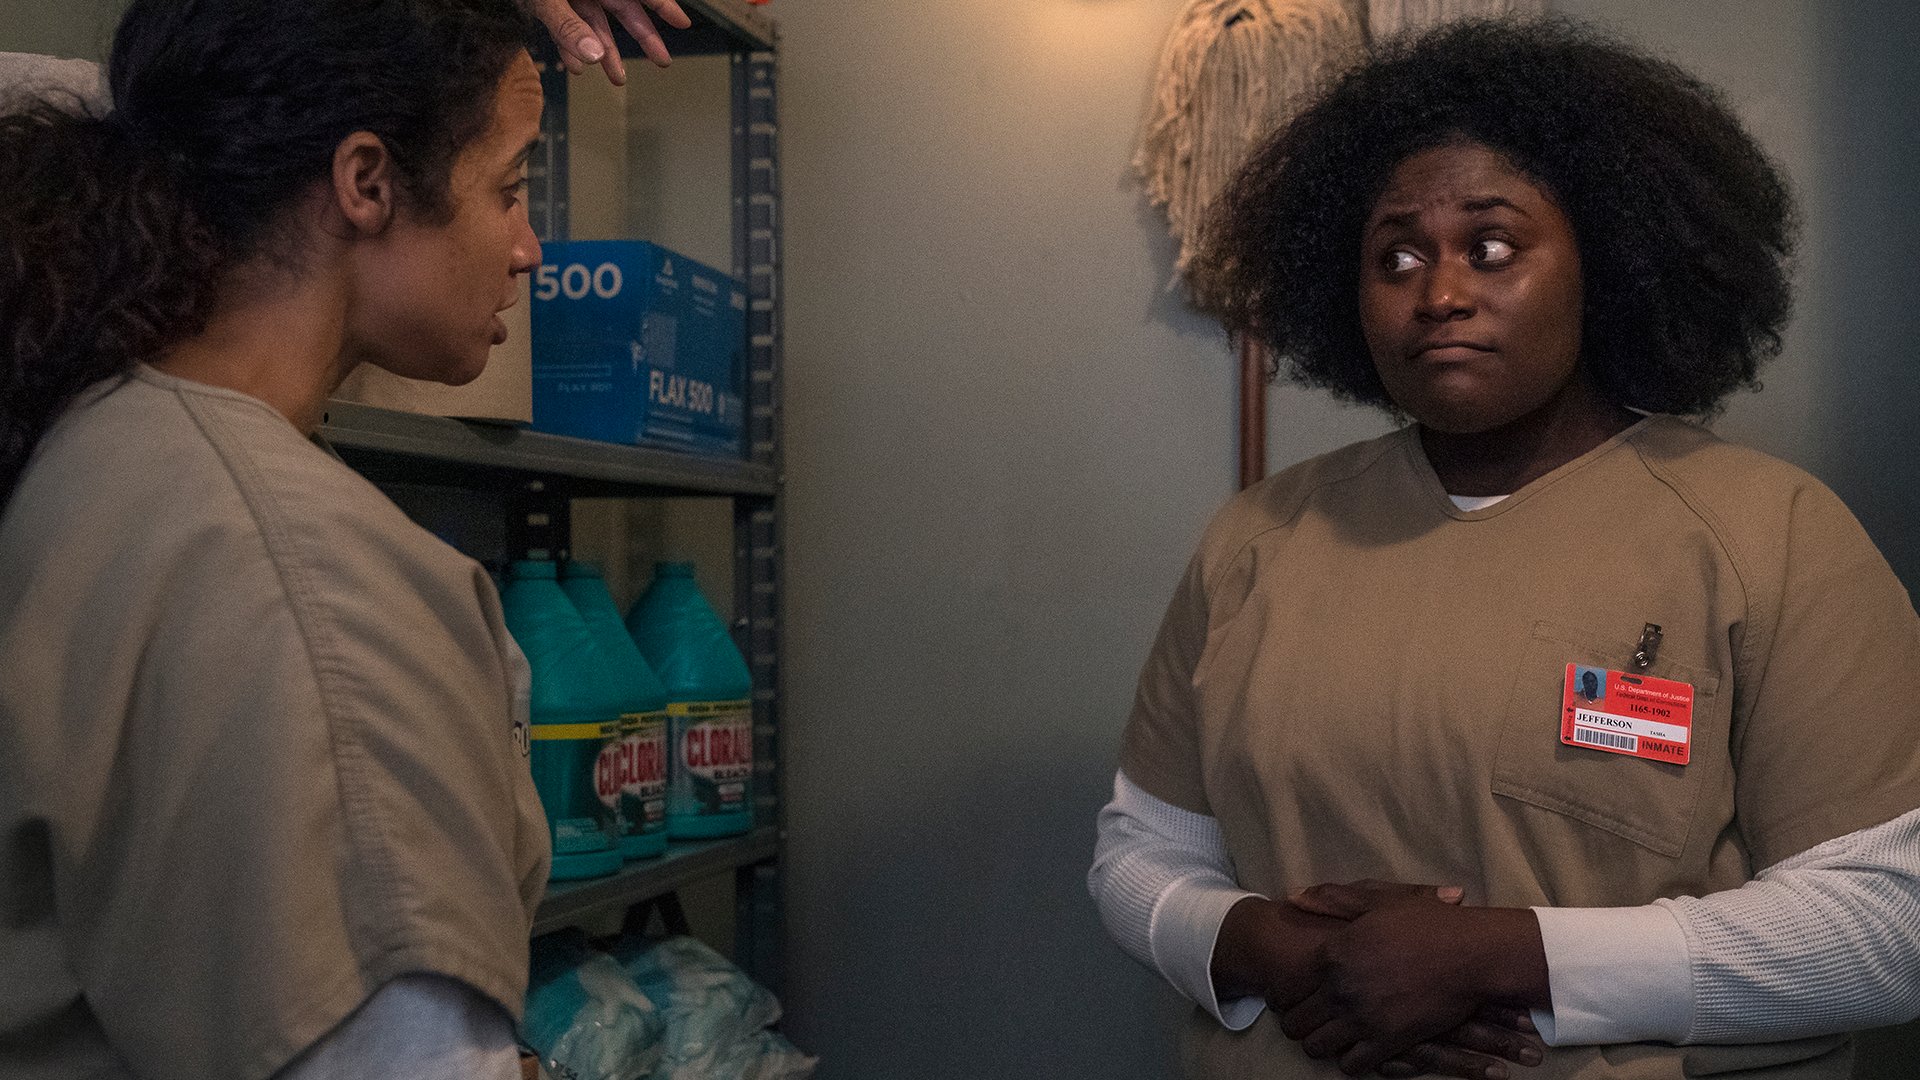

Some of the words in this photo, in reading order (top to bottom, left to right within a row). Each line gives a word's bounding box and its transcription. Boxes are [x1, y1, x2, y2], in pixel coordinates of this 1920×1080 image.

[535, 262, 623, 301] 500
[649, 369, 687, 408] FLAX
[688, 379, 714, 415] 500
[1614, 683, 1627, 691] U.S.
[1628, 686, 1662, 698] Department
[1669, 693, 1690, 702] Justice
[1630, 704, 1671, 718] 1165-1902
[1576, 713, 1633, 729] JEFFERSON
[1642, 740, 1685, 756] INMATE
